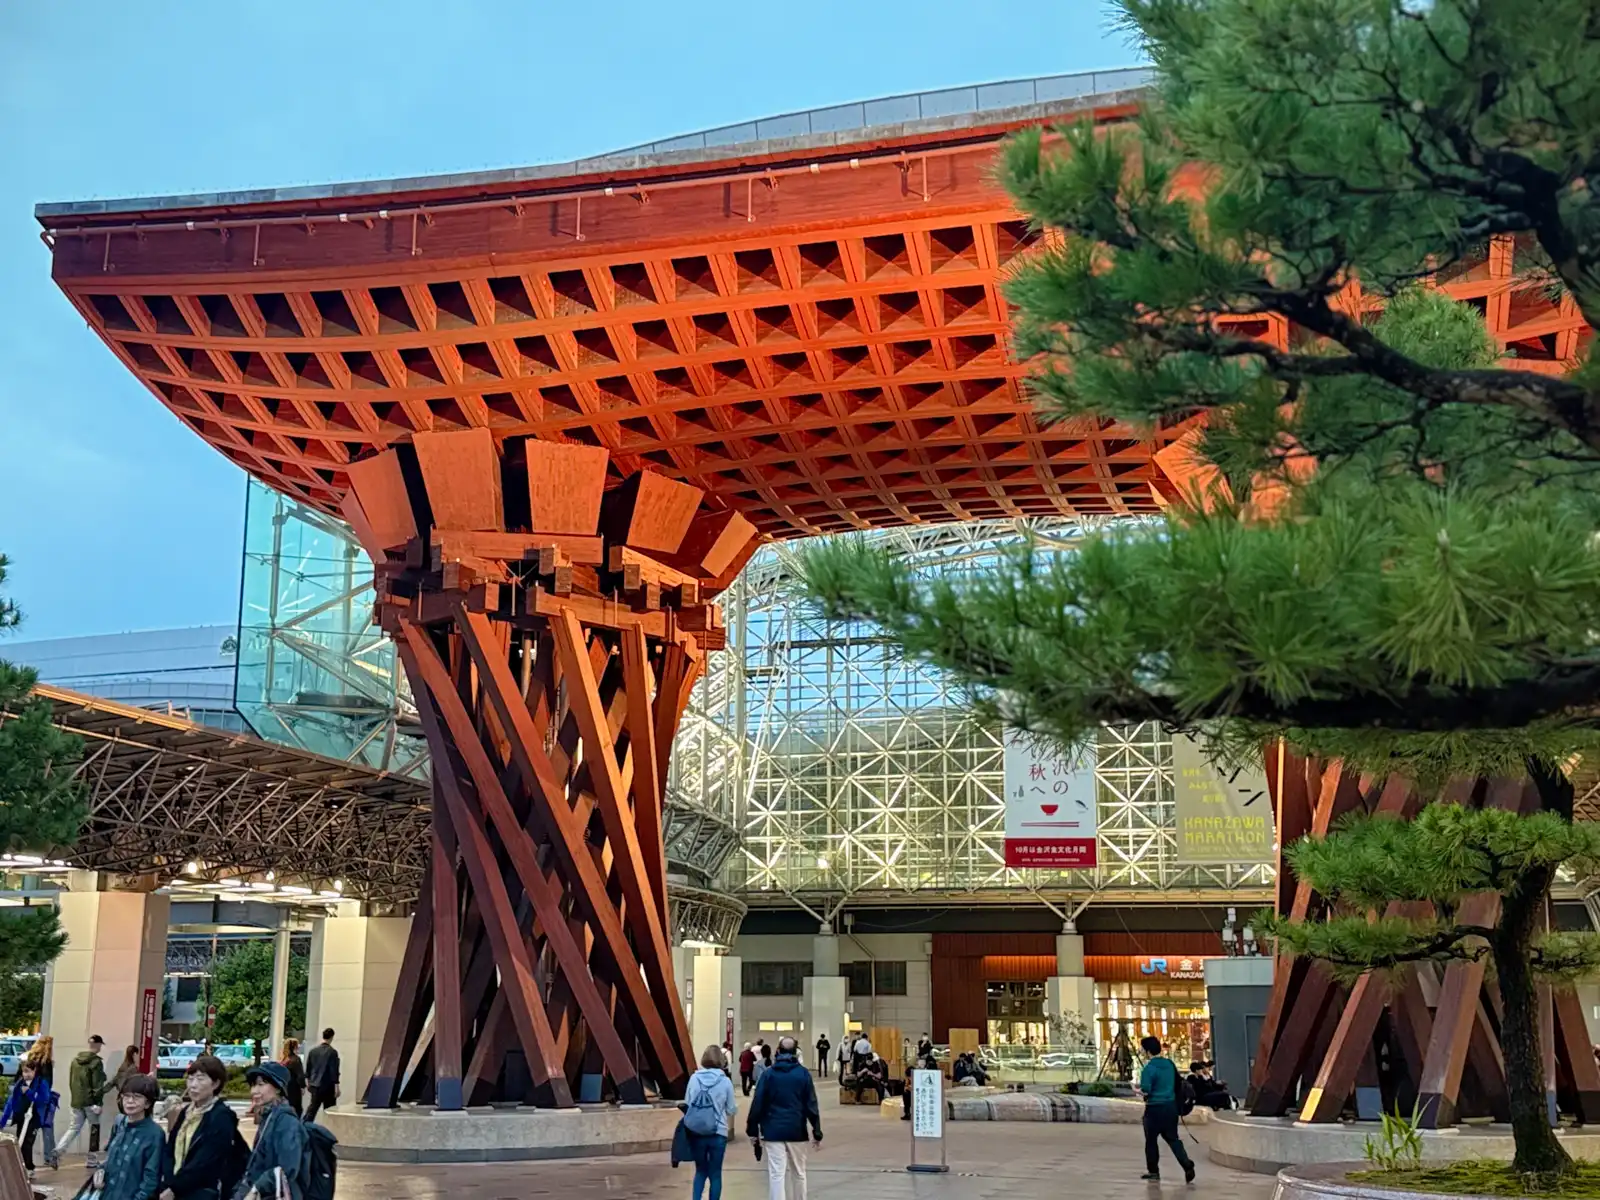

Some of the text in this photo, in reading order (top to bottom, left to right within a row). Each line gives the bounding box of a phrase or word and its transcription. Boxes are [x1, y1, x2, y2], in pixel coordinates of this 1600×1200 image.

[1184, 815, 1265, 830] KANAZAWA
[1184, 831, 1265, 845] MARATHON
[1141, 958, 1167, 974] JR
